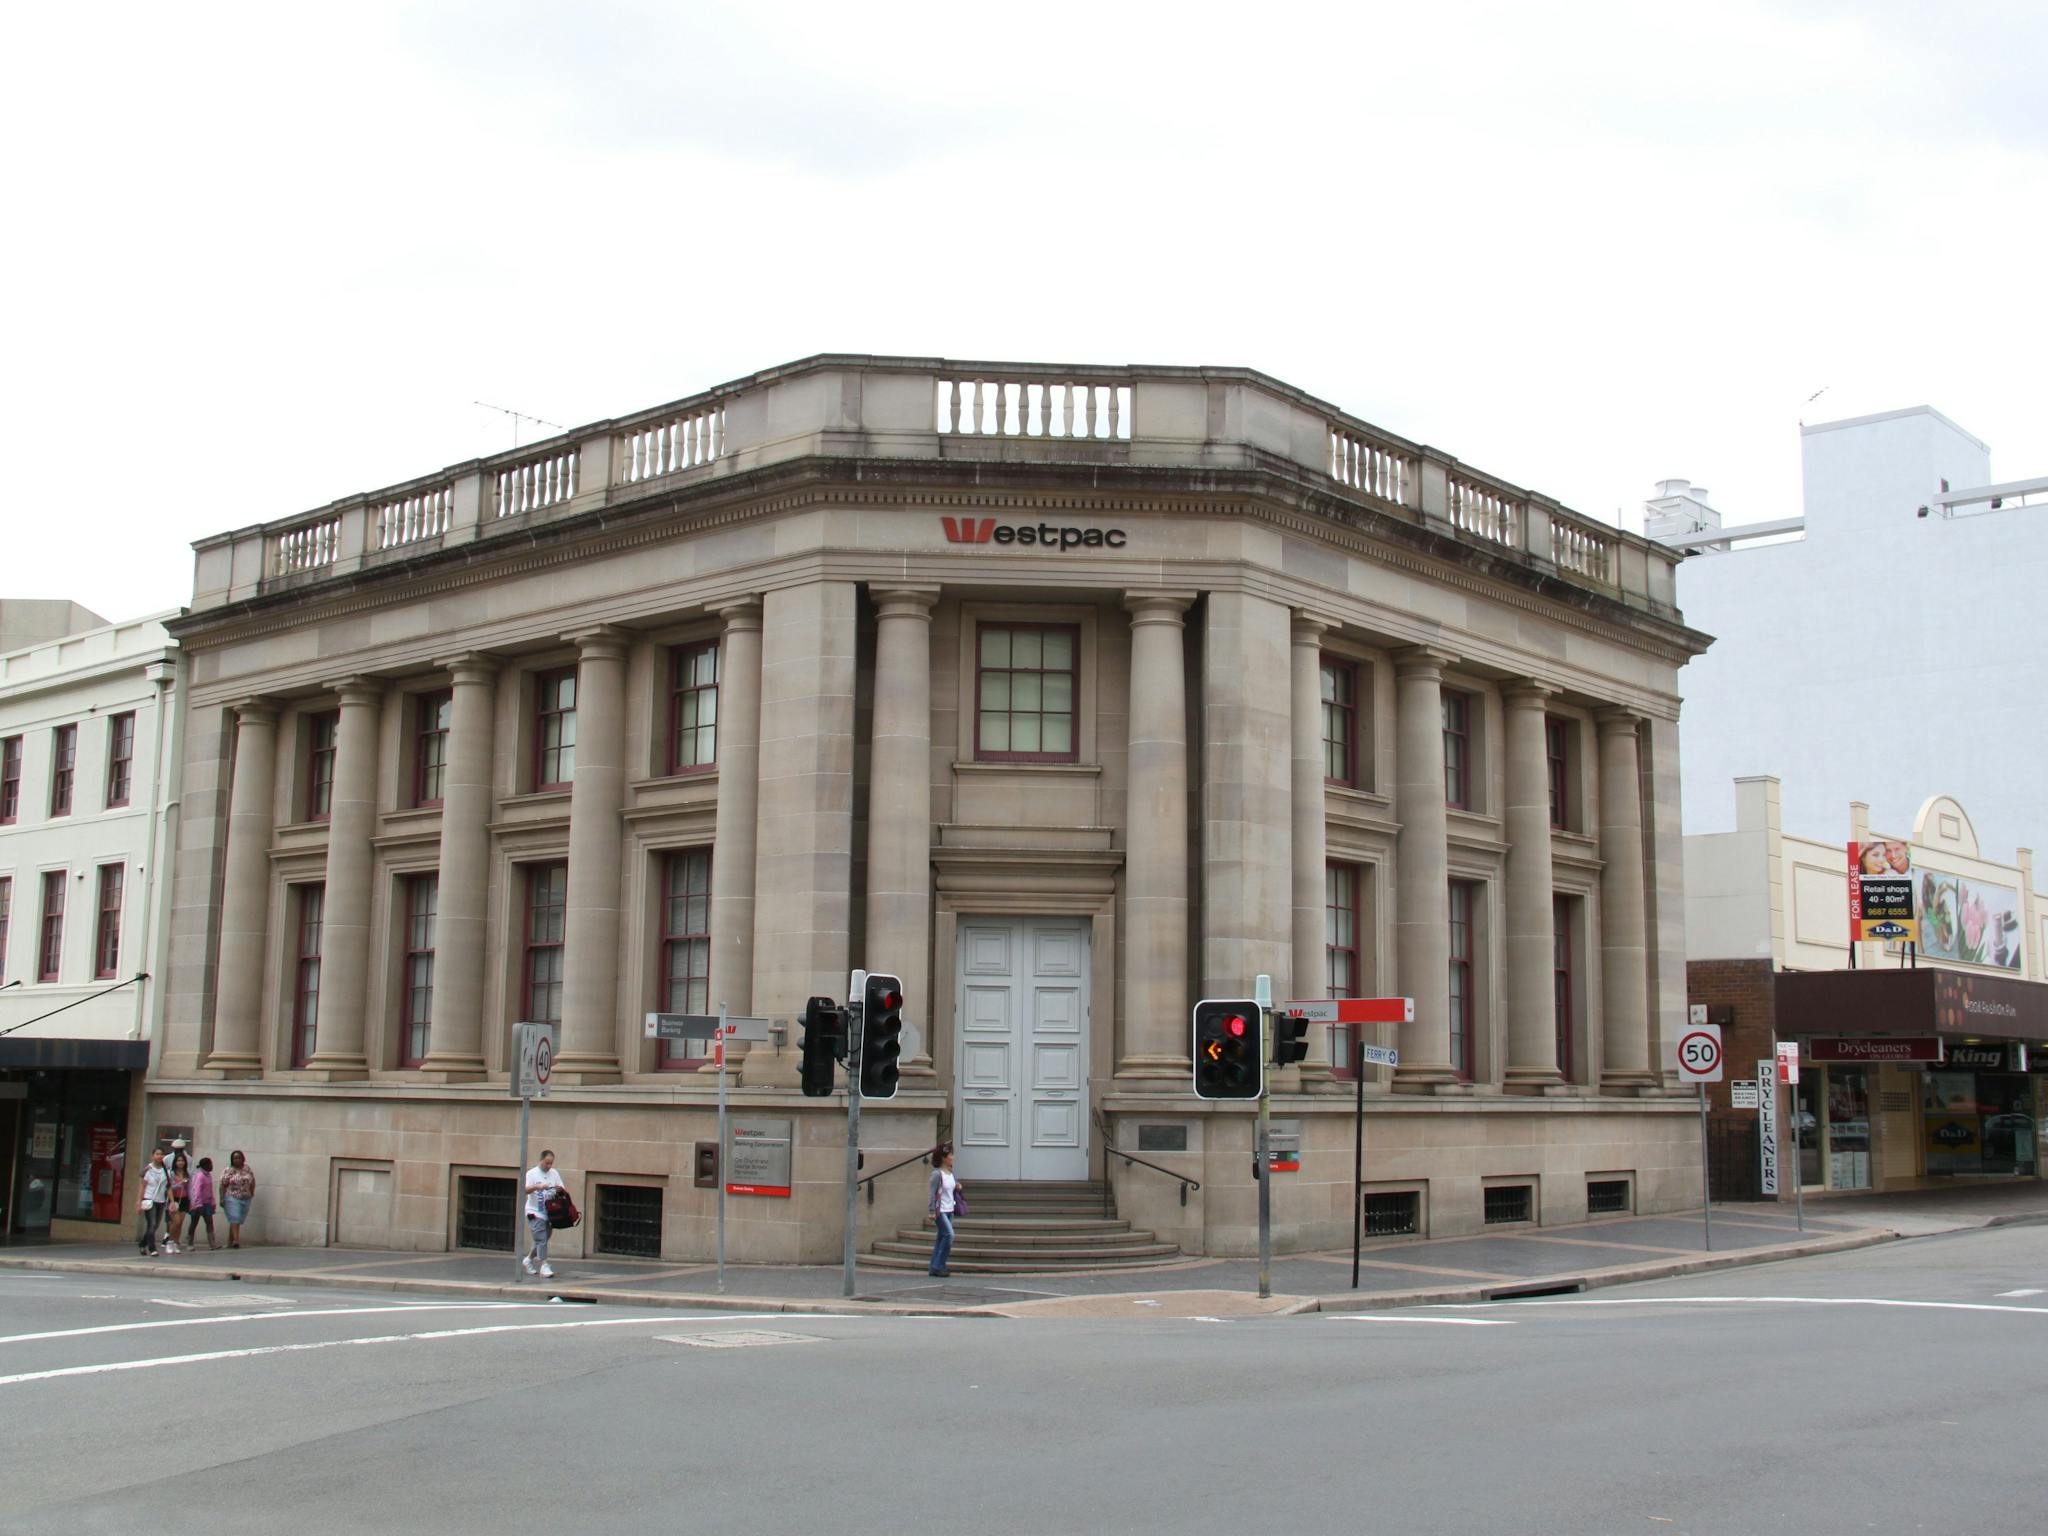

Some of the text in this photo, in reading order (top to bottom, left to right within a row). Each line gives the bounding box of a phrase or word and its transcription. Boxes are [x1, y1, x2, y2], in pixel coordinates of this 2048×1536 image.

[940, 516, 1127, 552] Westpac
[1850, 864, 1860, 919] FOR LEASE
[1863, 885, 1910, 894] Retail shops
[1868, 895, 1879, 903] 40
[1288, 1009, 1328, 1018] Westpac
[1366, 1048, 1387, 1059] FERRY
[1686, 1044, 1714, 1063] 50
[1838, 1041, 1912, 1056] Drycleaners
[539, 1050, 549, 1071] 40
[1952, 1049, 2001, 1067] King
[734, 1128, 766, 1137] Westpac
[1760, 1066, 1775, 1190] DRYCLEANERS
